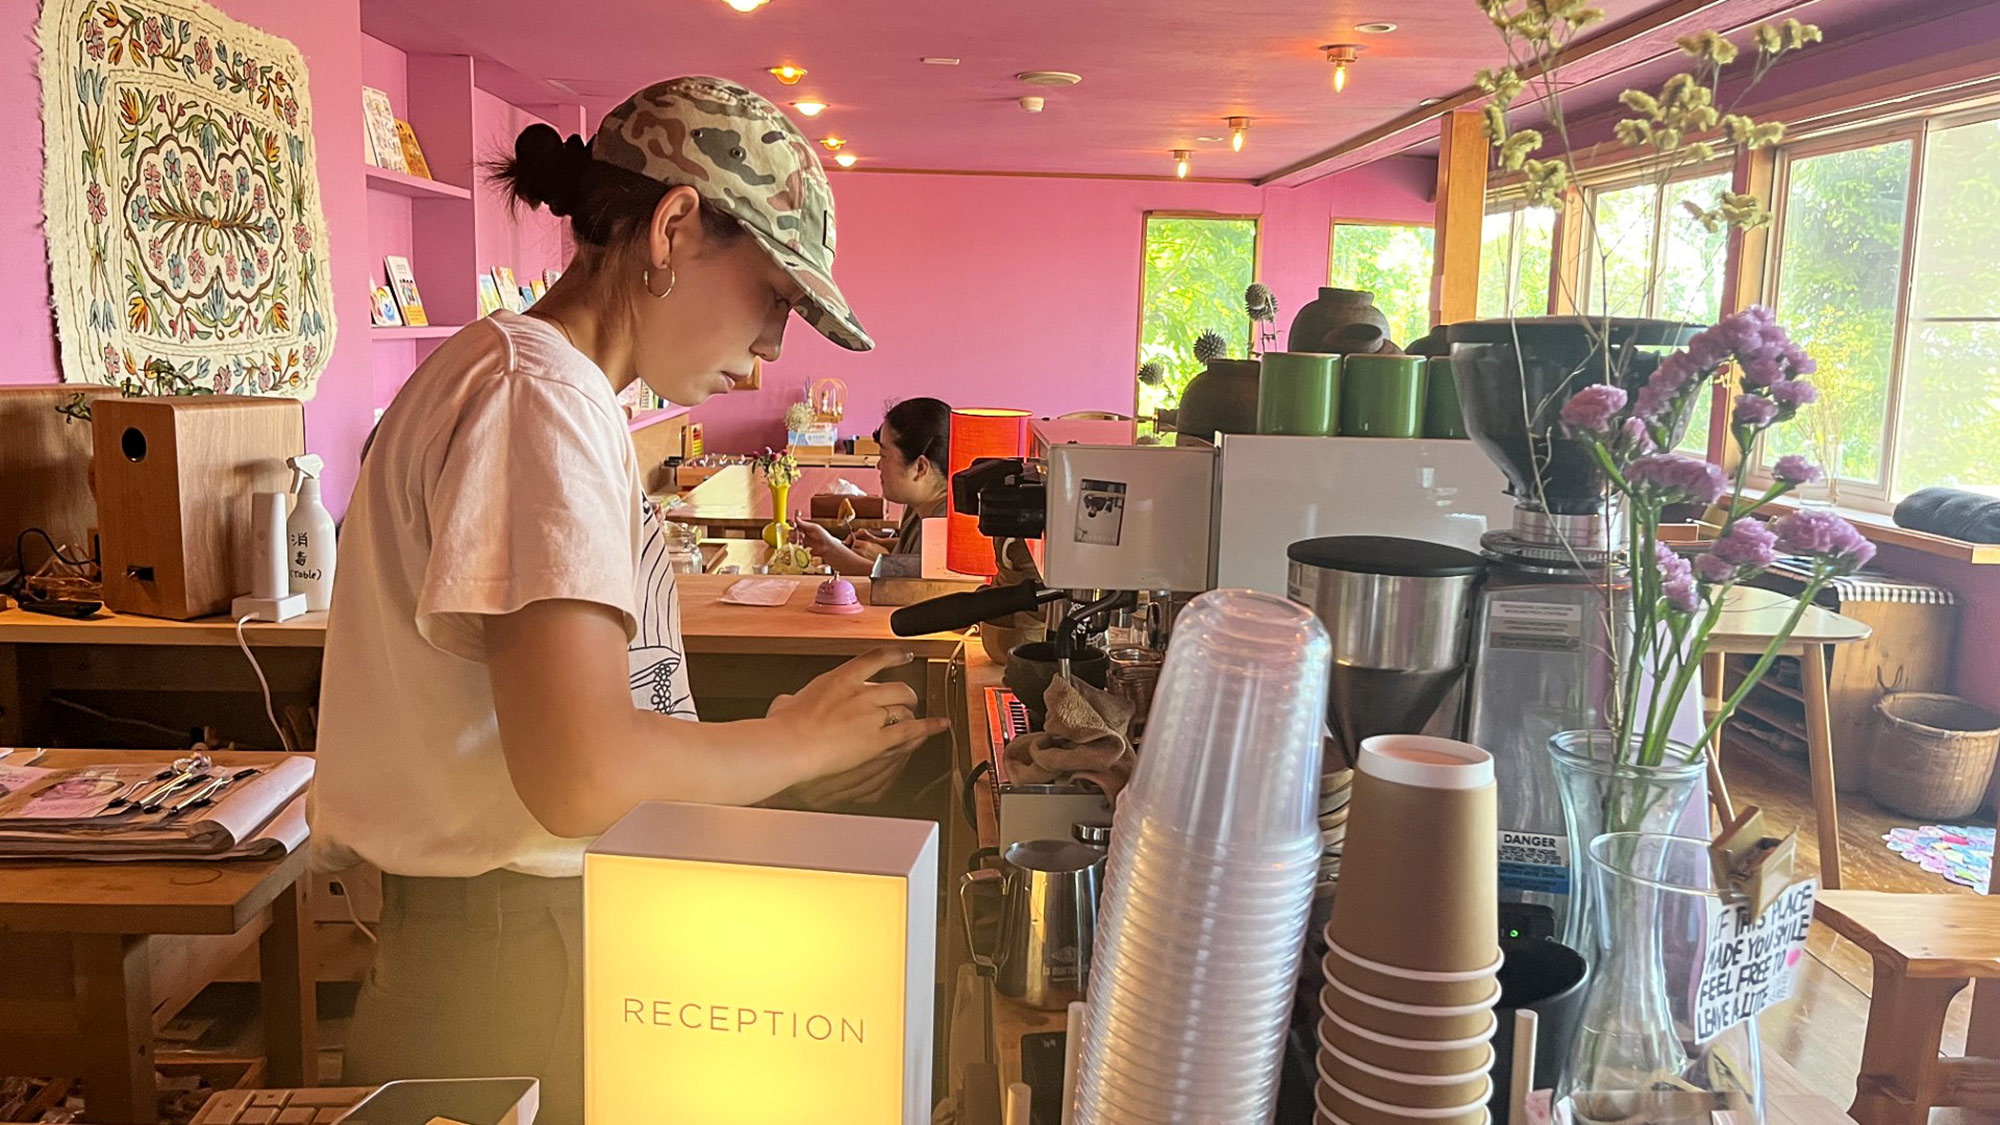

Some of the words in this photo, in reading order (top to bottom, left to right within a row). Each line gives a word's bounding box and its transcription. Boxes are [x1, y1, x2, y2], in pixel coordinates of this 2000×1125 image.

[290, 569, 322, 581] (Table)
[1504, 834, 1556, 848] DANGER
[1713, 908, 1730, 942] IF
[1772, 885, 1812, 925] PLACE
[1705, 939, 1744, 975] MADE
[1748, 930, 1774, 961] YOU
[1773, 914, 1810, 949] SMILE
[1699, 971, 1734, 1008] FEEL
[1735, 954, 1772, 993] FREE
[624, 998, 864, 1044] RECEPTION
[1697, 1000, 1730, 1039] LEAVE
